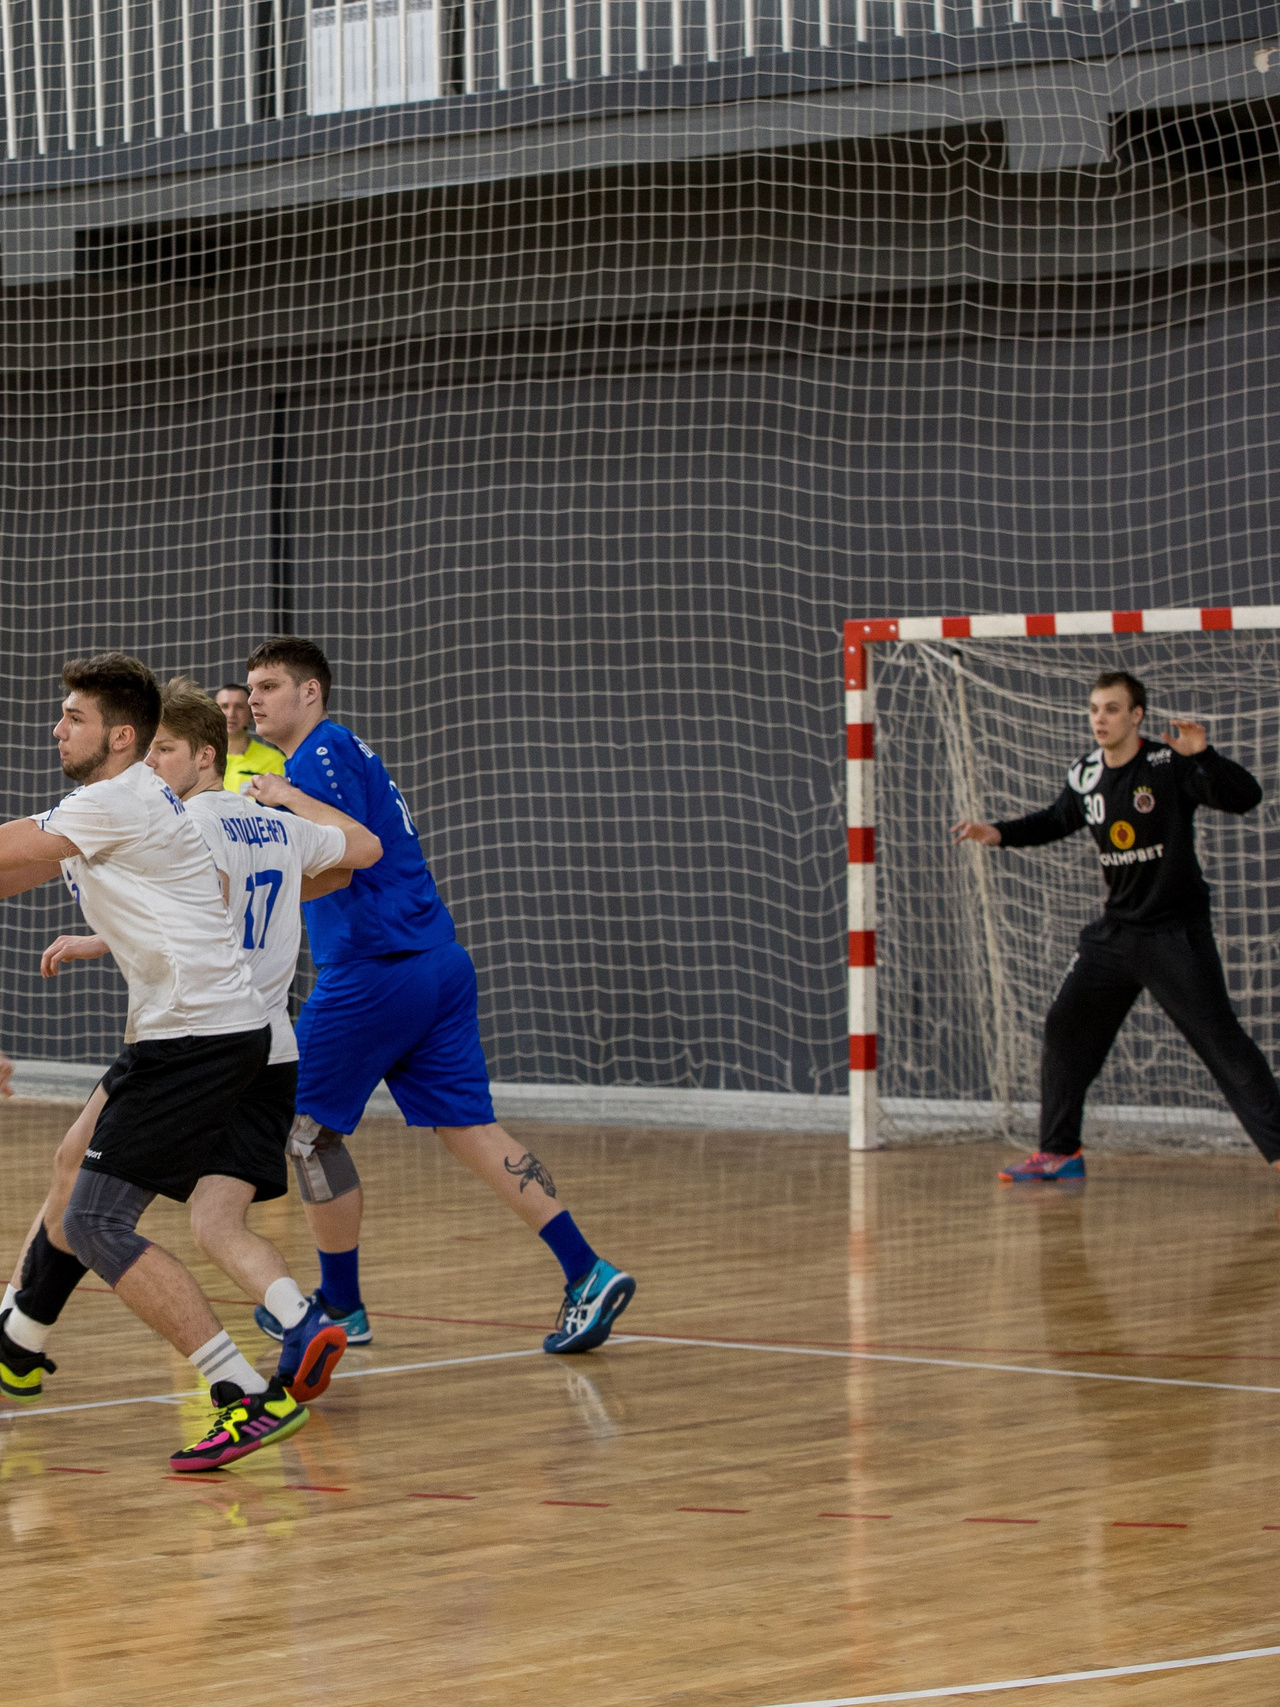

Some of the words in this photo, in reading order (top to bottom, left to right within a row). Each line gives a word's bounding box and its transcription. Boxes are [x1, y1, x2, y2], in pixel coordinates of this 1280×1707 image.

[1083, 793, 1106, 825] 30
[1099, 843, 1164, 867] OLIMPBET
[242, 869, 283, 949] 17
